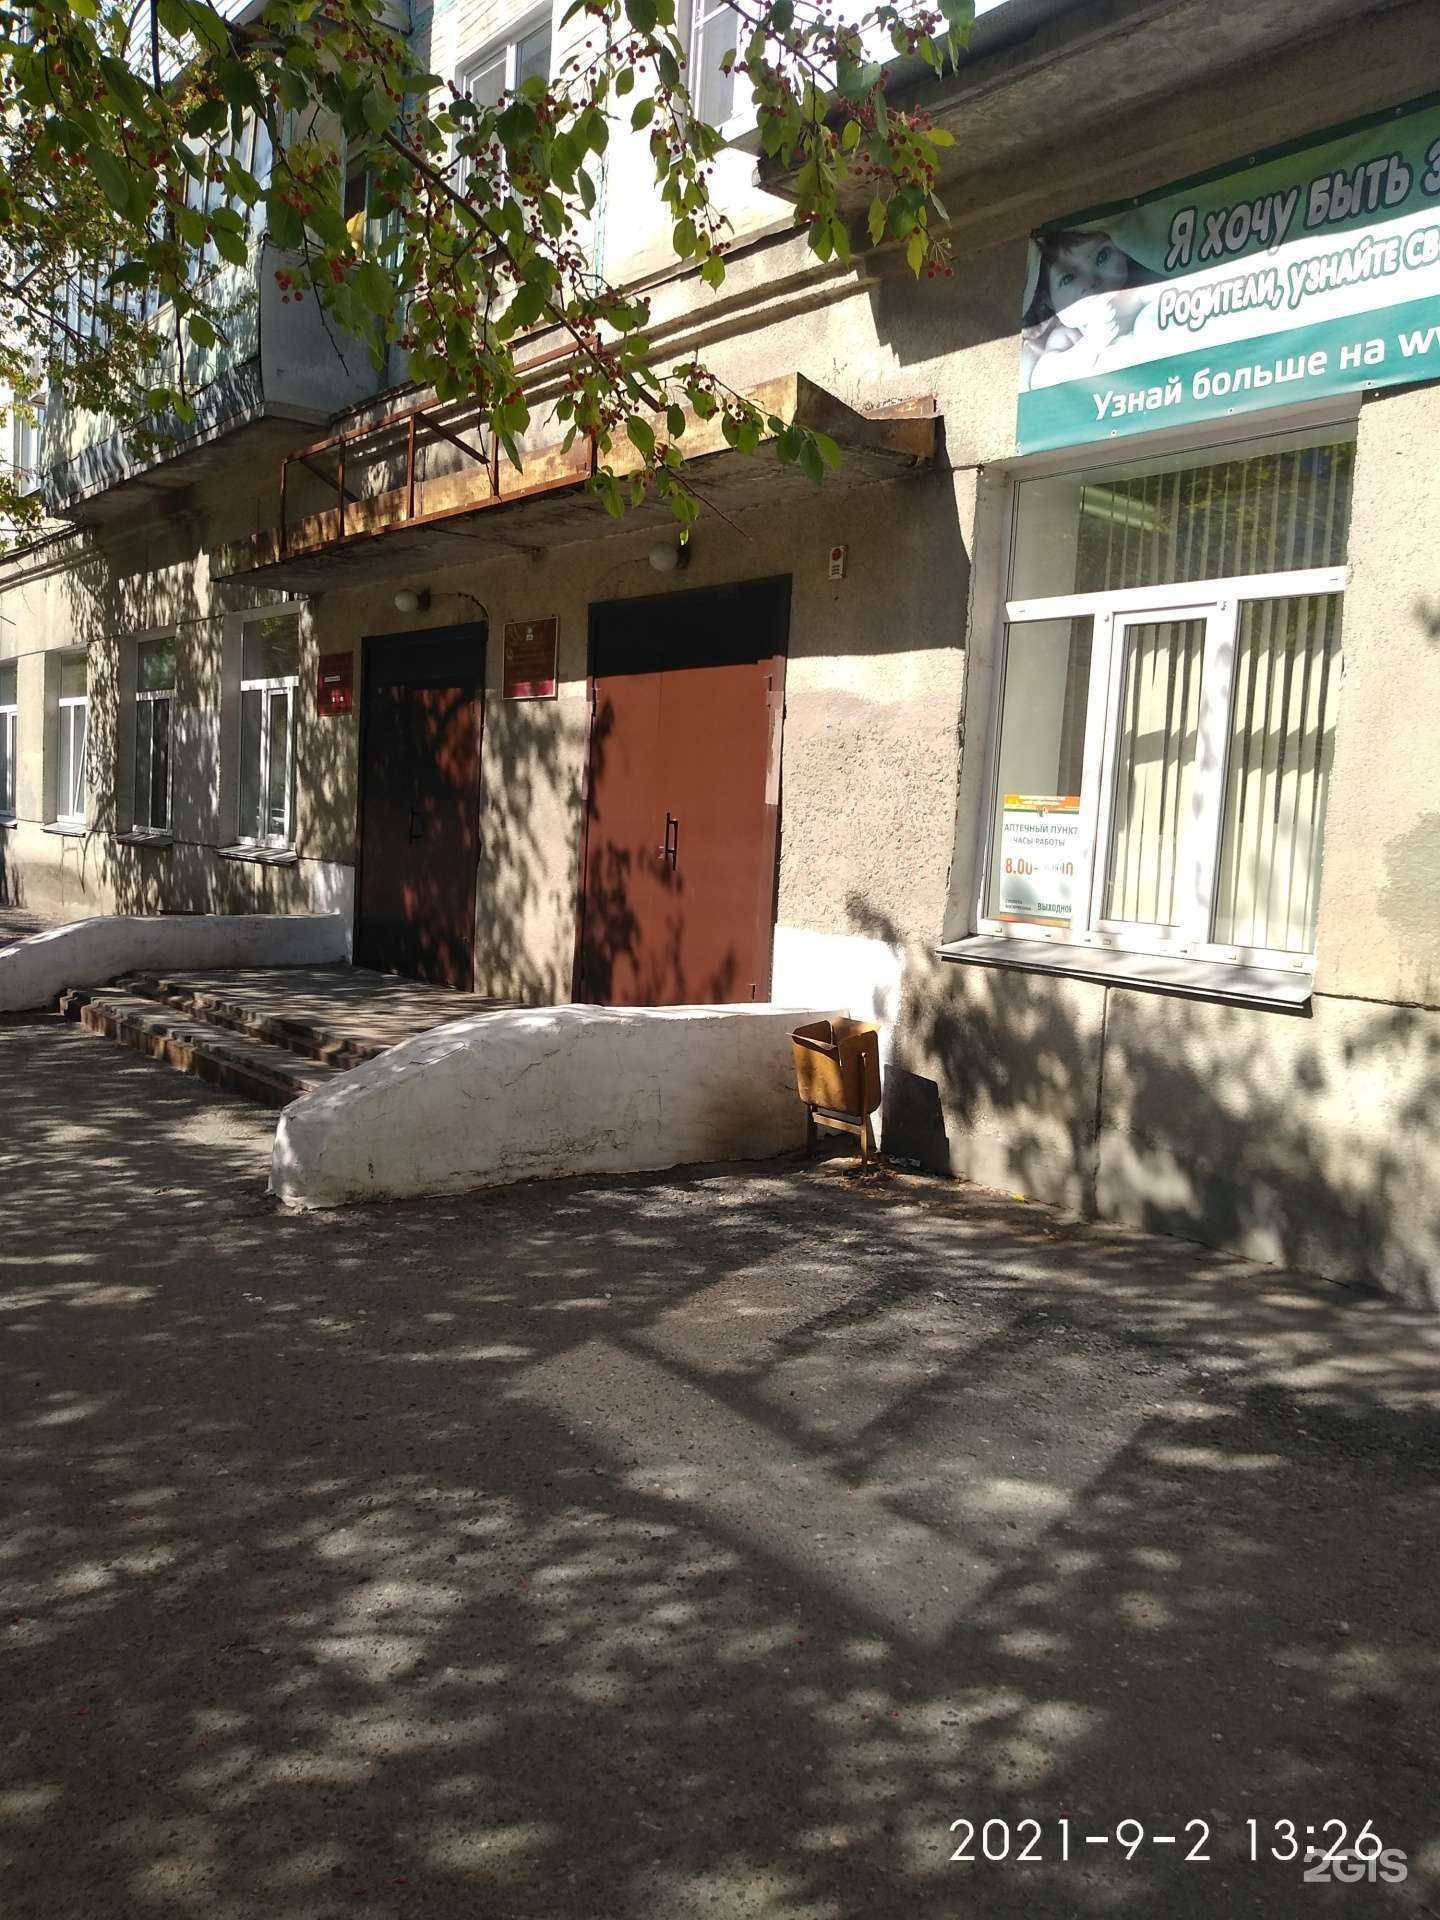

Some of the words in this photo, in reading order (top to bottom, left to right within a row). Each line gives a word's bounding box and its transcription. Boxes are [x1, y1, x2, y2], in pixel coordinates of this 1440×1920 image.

[1165, 208, 1199, 271] Я
[1304, 152, 1412, 229] БЫТЬ
[1093, 377, 1182, 420] Узнай
[1192, 357, 1327, 399] больше
[1339, 338, 1385, 370] на
[1004, 823, 1049, 833] АПТЕЧНЫЙ
[1050, 825, 1079, 835] ПУНКТ
[1013, 836, 1034, 845] ЧАСЫ
[1035, 837, 1066, 847] РАБОТЫ
